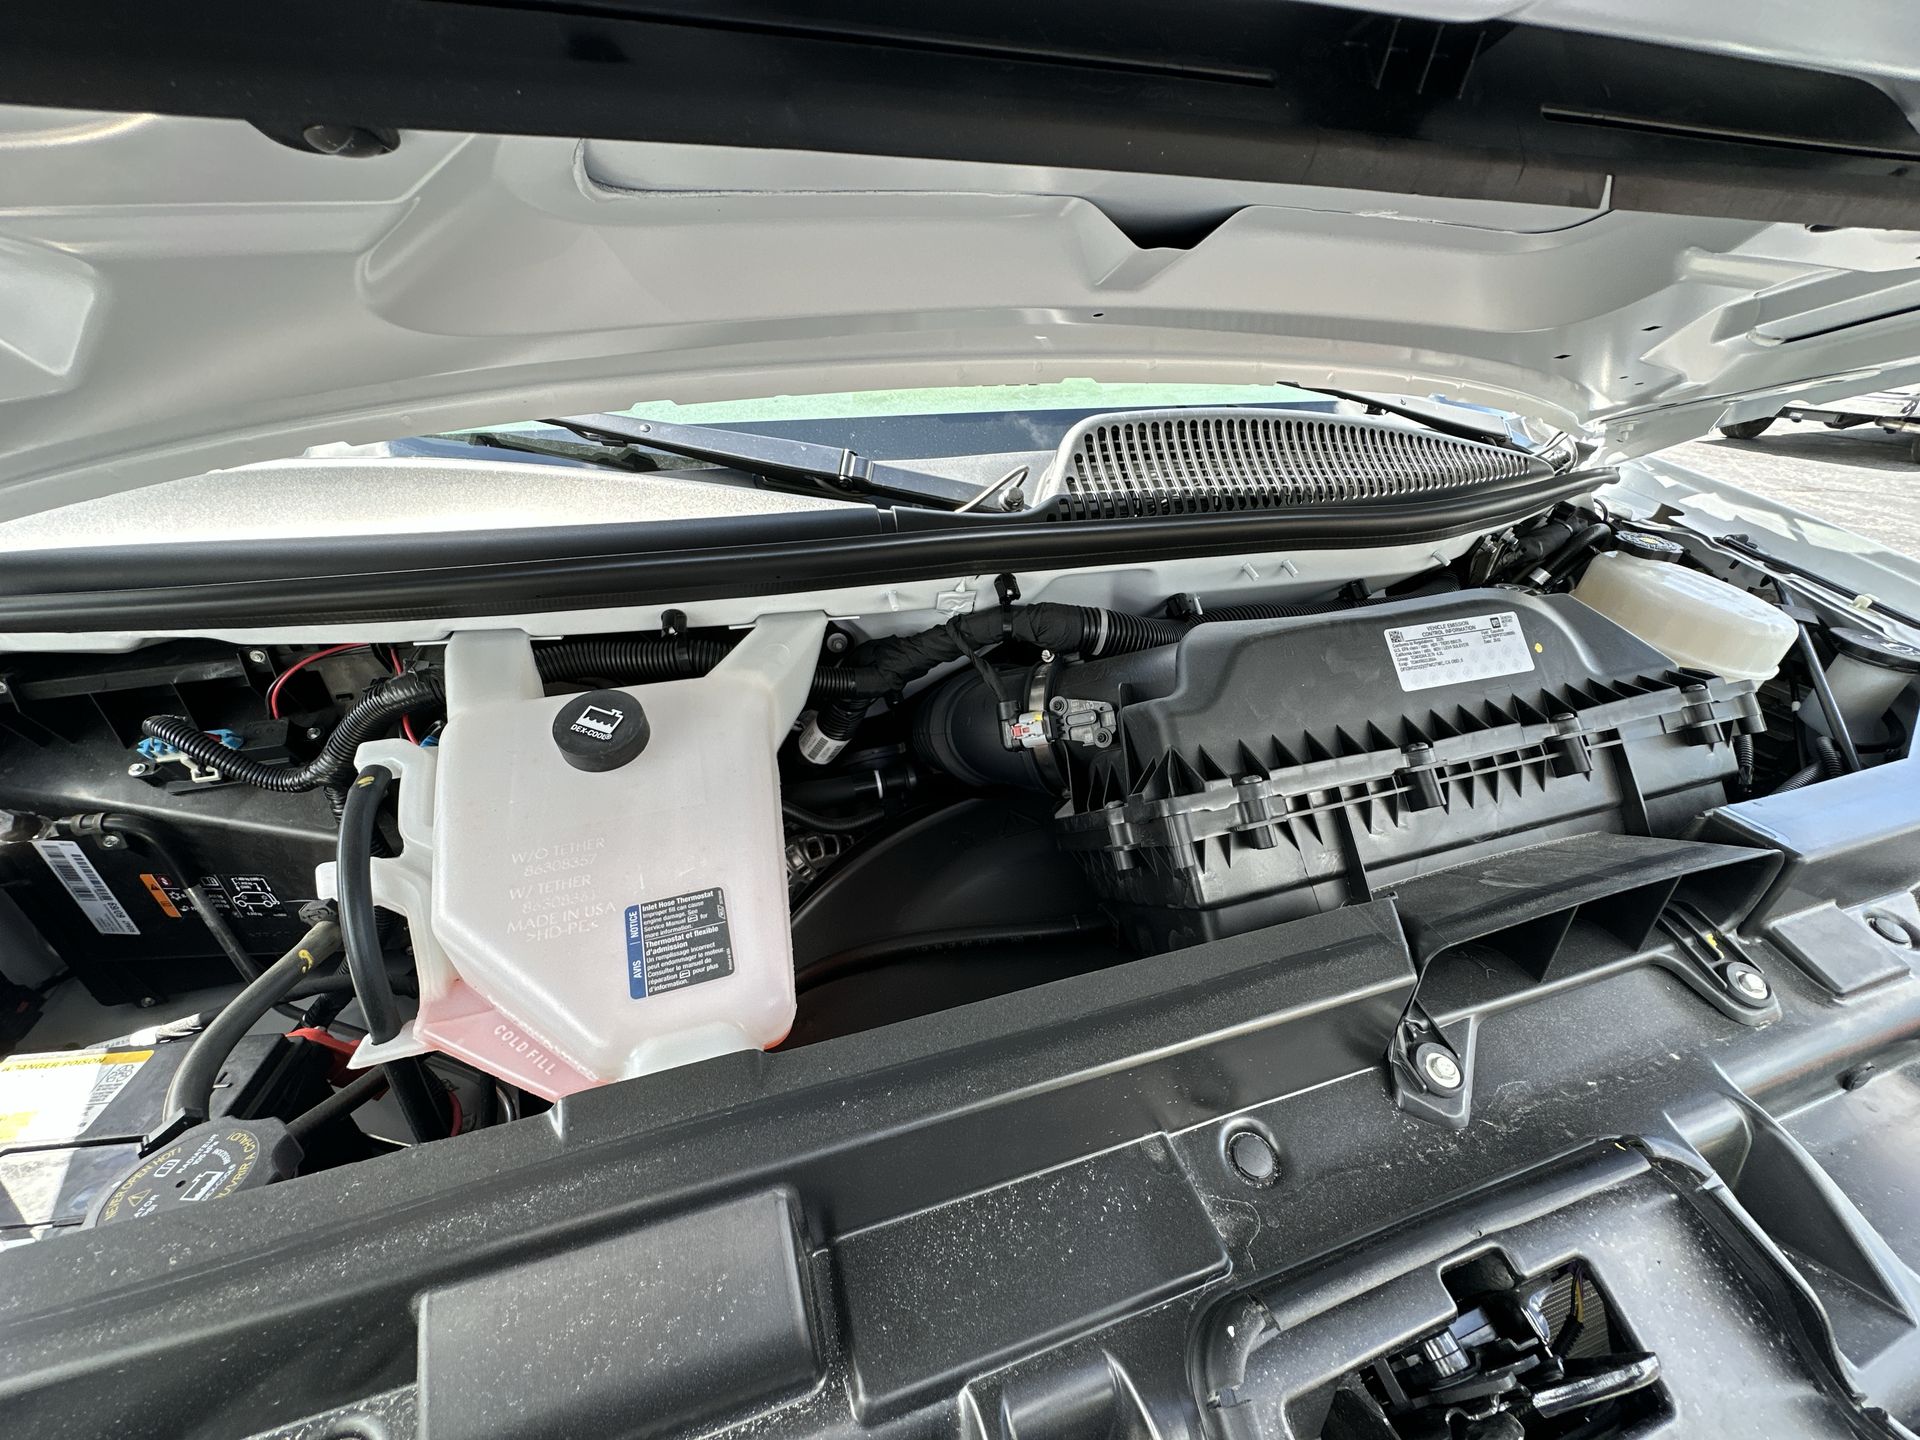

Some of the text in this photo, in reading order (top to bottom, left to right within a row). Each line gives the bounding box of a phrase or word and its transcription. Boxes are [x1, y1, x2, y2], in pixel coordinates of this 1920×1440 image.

[1444, 624, 1476, 633] INFORMATION
[1446, 620, 1469, 628] EMISSION
[511, 838, 605, 865] W/O TETHER
[508, 874, 592, 901] W/ TETHER
[642, 903, 657, 911] Inlet
[658, 898, 675, 907] Hose
[676, 890, 713, 903] Thermostat
[642, 908, 667, 919] Improper
[687, 900, 704, 908] cause
[506, 901, 617, 935] MADE IN USA
[628, 910, 638, 938] NOTICE
[643, 917, 662, 925] engine
[643, 922, 664, 932] Service
[665, 917, 685, 927] Manual
[645, 933, 684, 948] Thermostat
[693, 925, 718, 936] flexible
[659, 923, 692, 935] information.
[645, 940, 688, 956] d'admission
[655, 947, 689, 961] remplissage
[690, 941, 715, 952] incorrect
[632, 959, 642, 979] AVIS
[646, 962, 659, 971] peut
[660, 952, 696, 967] endommager
[647, 965, 675, 978] Consulter
[682, 958, 703, 968] manuel
[703, 955, 712, 963] de
[647, 961, 718, 986] réparation pour plus
[494, 1024, 556, 1076] COLD FILL
[225, 1131, 257, 1153] CHAUD!
[176, 1133, 219, 1174] RADIATEUR
[121, 1164, 153, 1190] OPEN
[152, 1146, 182, 1166] HOT!
